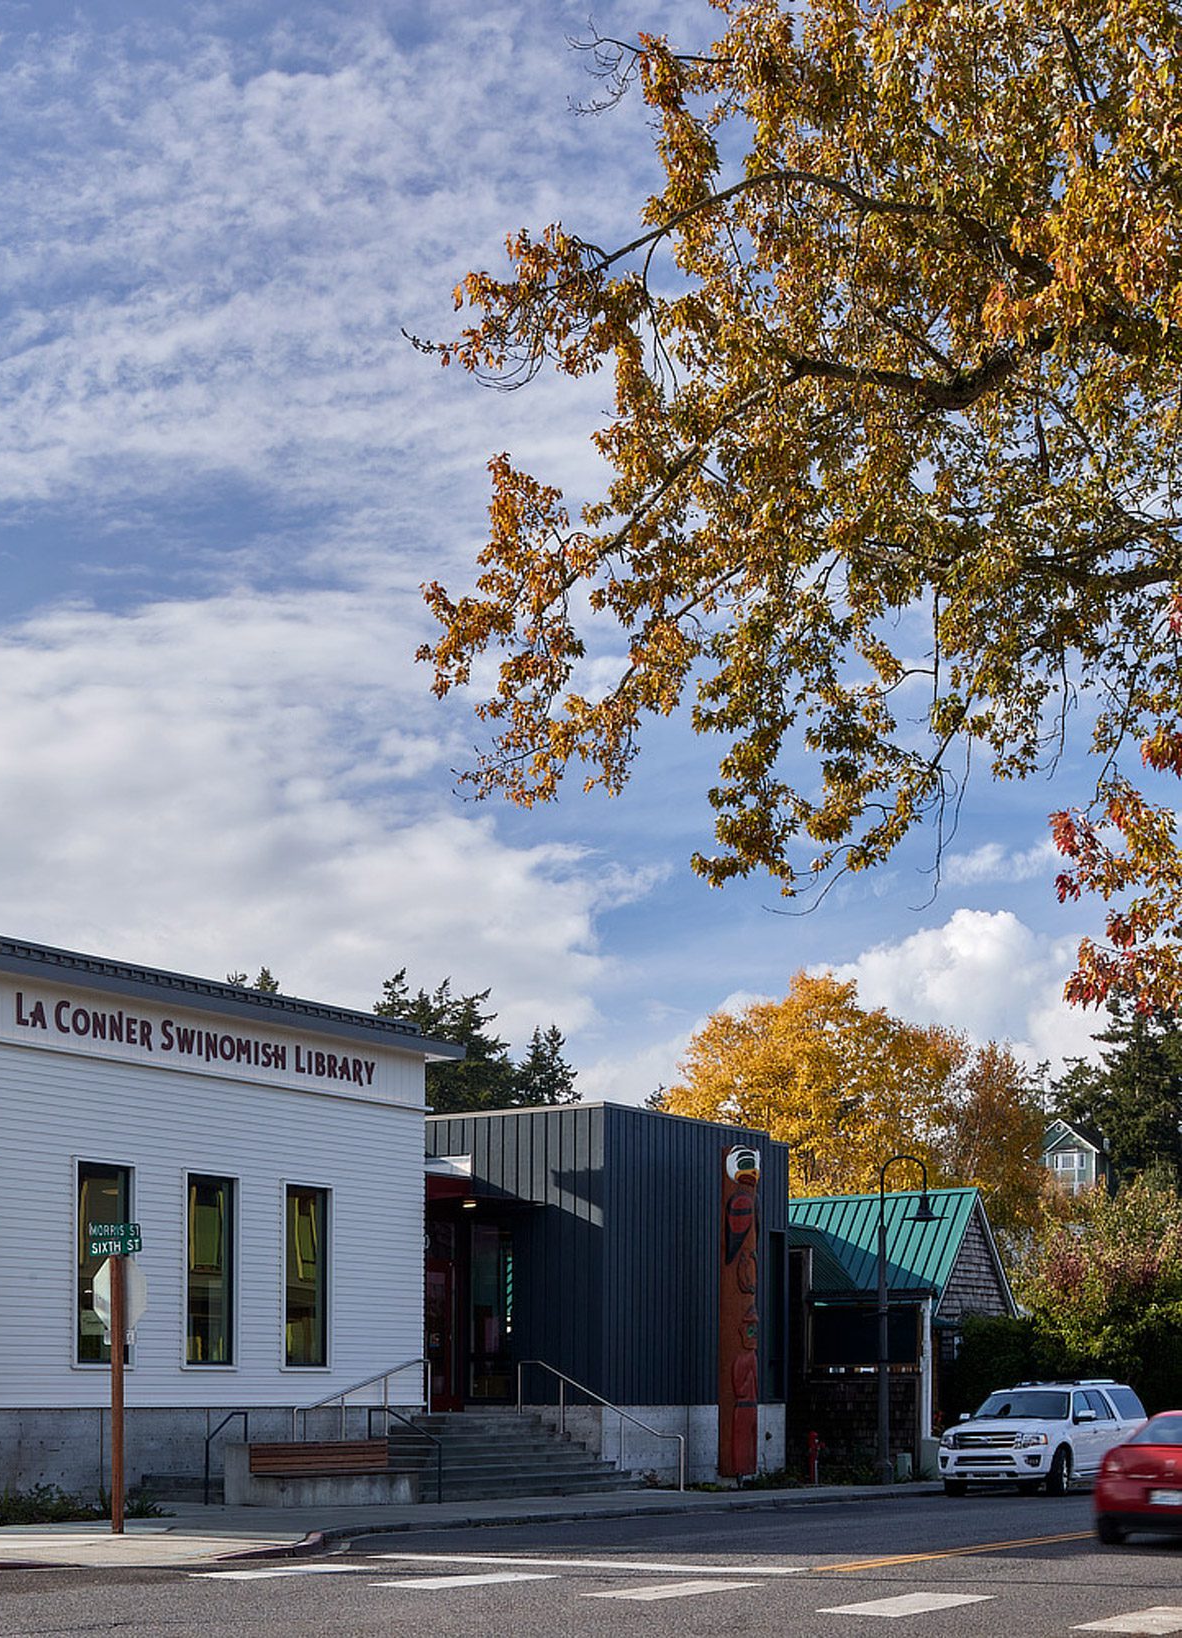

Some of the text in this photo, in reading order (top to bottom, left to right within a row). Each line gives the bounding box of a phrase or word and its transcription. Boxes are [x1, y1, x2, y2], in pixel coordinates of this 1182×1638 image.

[16, 992, 376, 1087] LA CONNER SWINOMISH LIBRARY
[89, 1223, 140, 1237] MORRIS ST
[91, 1239, 140, 1255] SIXTH ST
